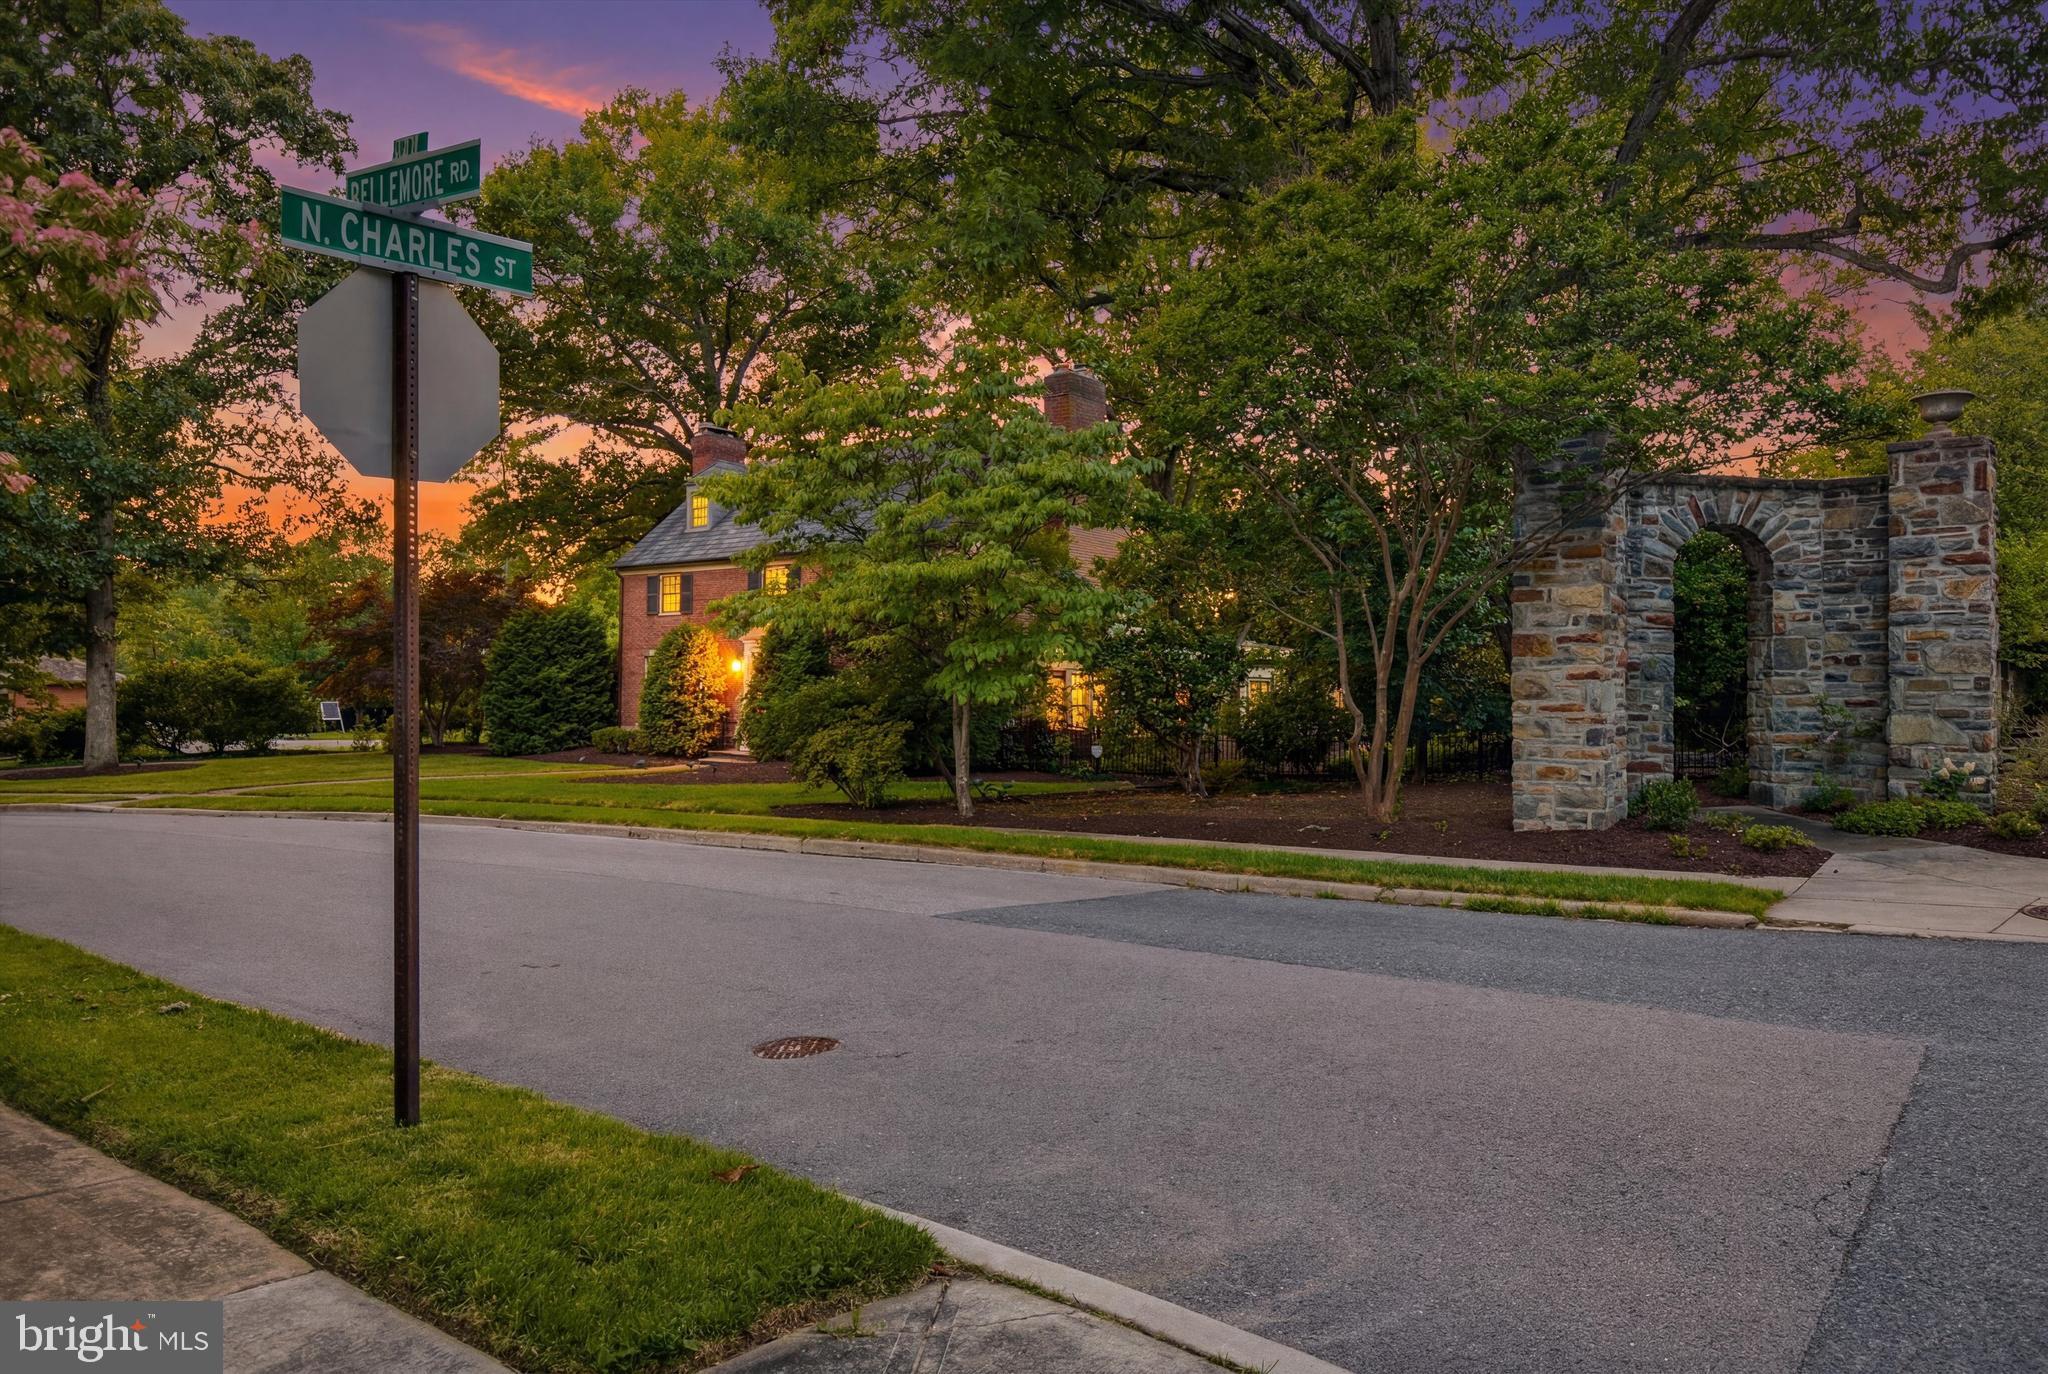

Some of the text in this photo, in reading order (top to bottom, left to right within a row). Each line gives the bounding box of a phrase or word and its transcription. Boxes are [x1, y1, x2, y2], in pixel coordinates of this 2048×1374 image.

[302, 202, 517, 280] N. CHARLES ST
